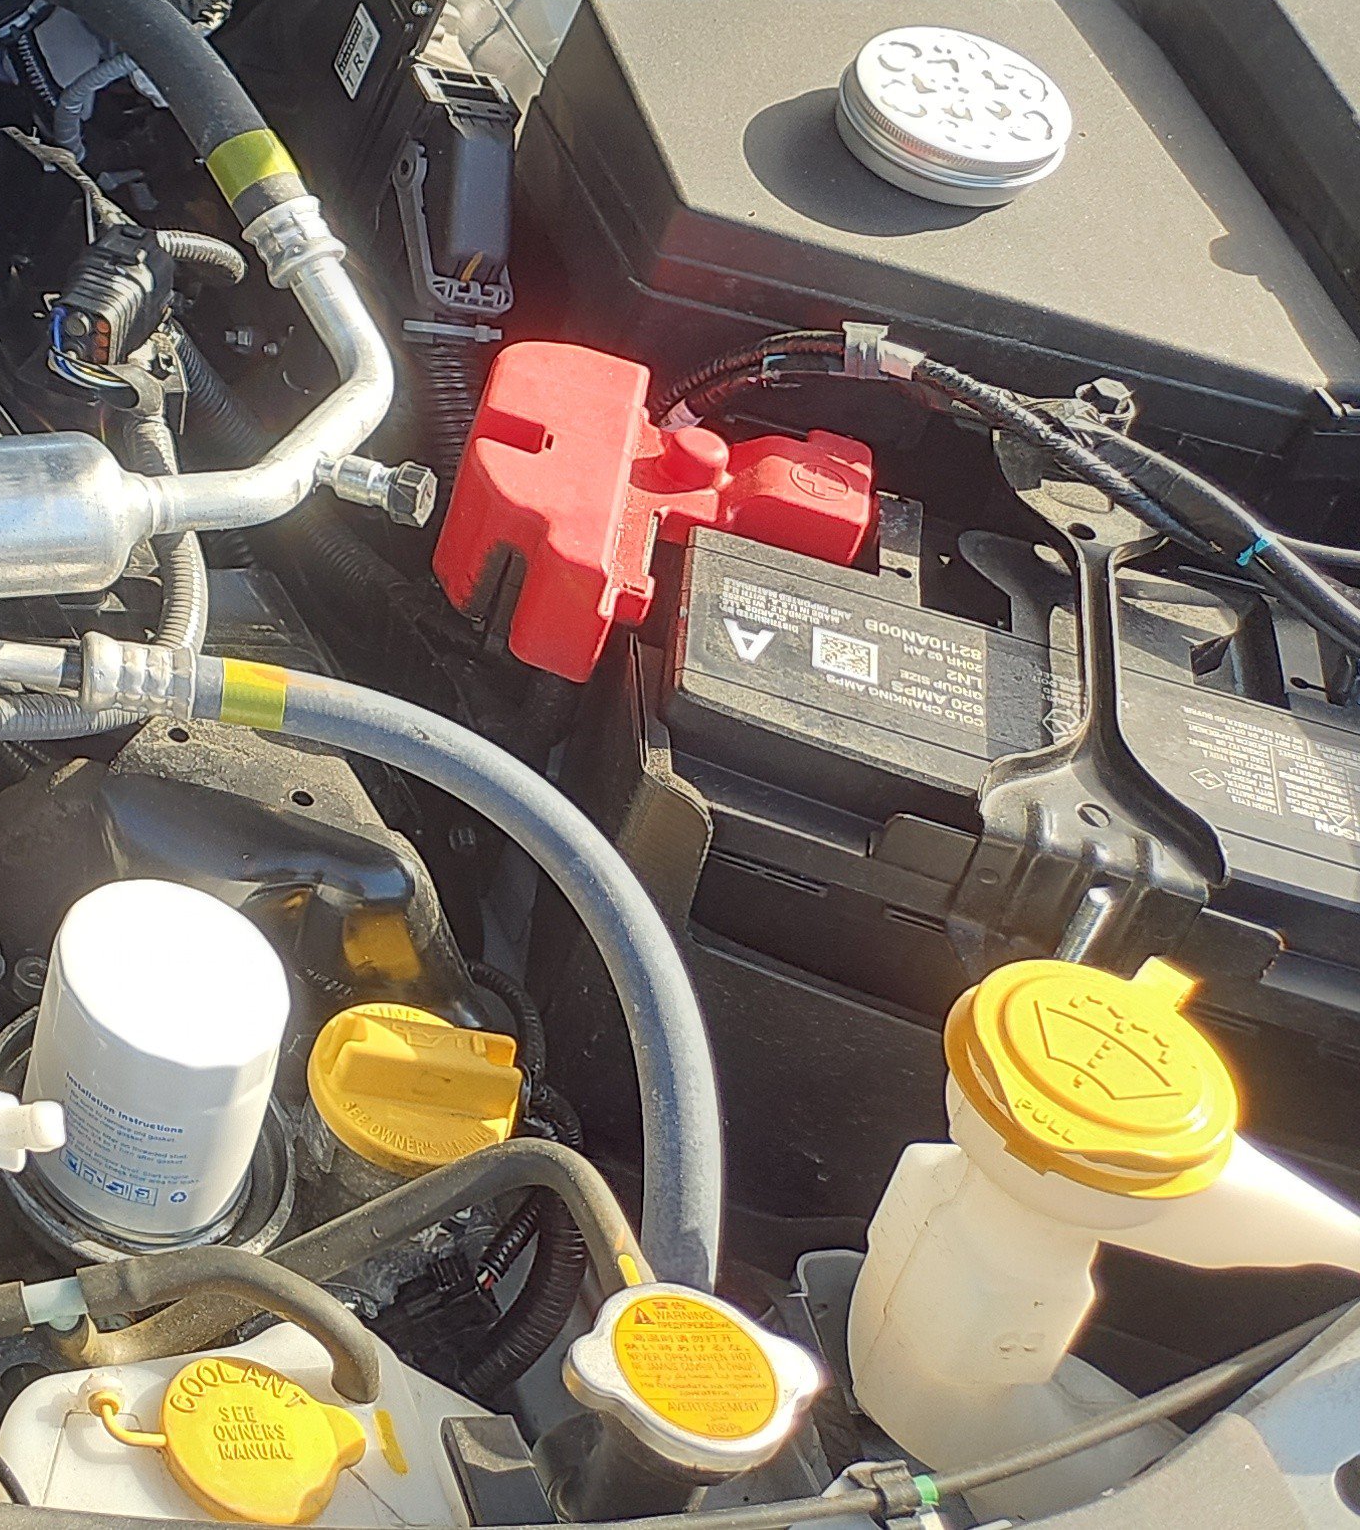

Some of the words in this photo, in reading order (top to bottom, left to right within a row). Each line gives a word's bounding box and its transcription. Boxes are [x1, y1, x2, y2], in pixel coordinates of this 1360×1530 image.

[864, 618, 982, 661] 82110AN00B
[903, 643, 924, 656] AH
[947, 656, 983, 673] 20HR
[826, 674, 866, 692] AMPS
[899, 669, 931, 685] SIZE
[946, 669, 983, 689] LN2
[891, 680, 947, 705] AMPS
[933, 680, 984, 700] GROUP
[868, 687, 942, 716] CRANKING
[951, 698, 984, 716] 620
[945, 709, 985, 727] COLD
[66, 1070, 115, 1115] Installation
[118, 1111, 183, 1134] Instructions
[341, 1100, 370, 1126] SEE
[368, 1122, 440, 1157] OWNER'S
[444, 1125, 494, 1157] MANUA
[1015, 1097, 1075, 1145] PULL
[653, 1311, 715, 1321] WARNING
[627, 1351, 662, 1362] NEVER
[664, 1352, 691, 1362] OPEN
[696, 1352, 727, 1362] WHEN
[169, 1361, 308, 1414] COOLANT
[218, 1406, 257, 1423] SEE
[667, 1401, 759, 1412] AVERTISSEMENT
[213, 1423, 286, 1442] OWNERS
[217, 1442, 294, 1460] MANUAL
